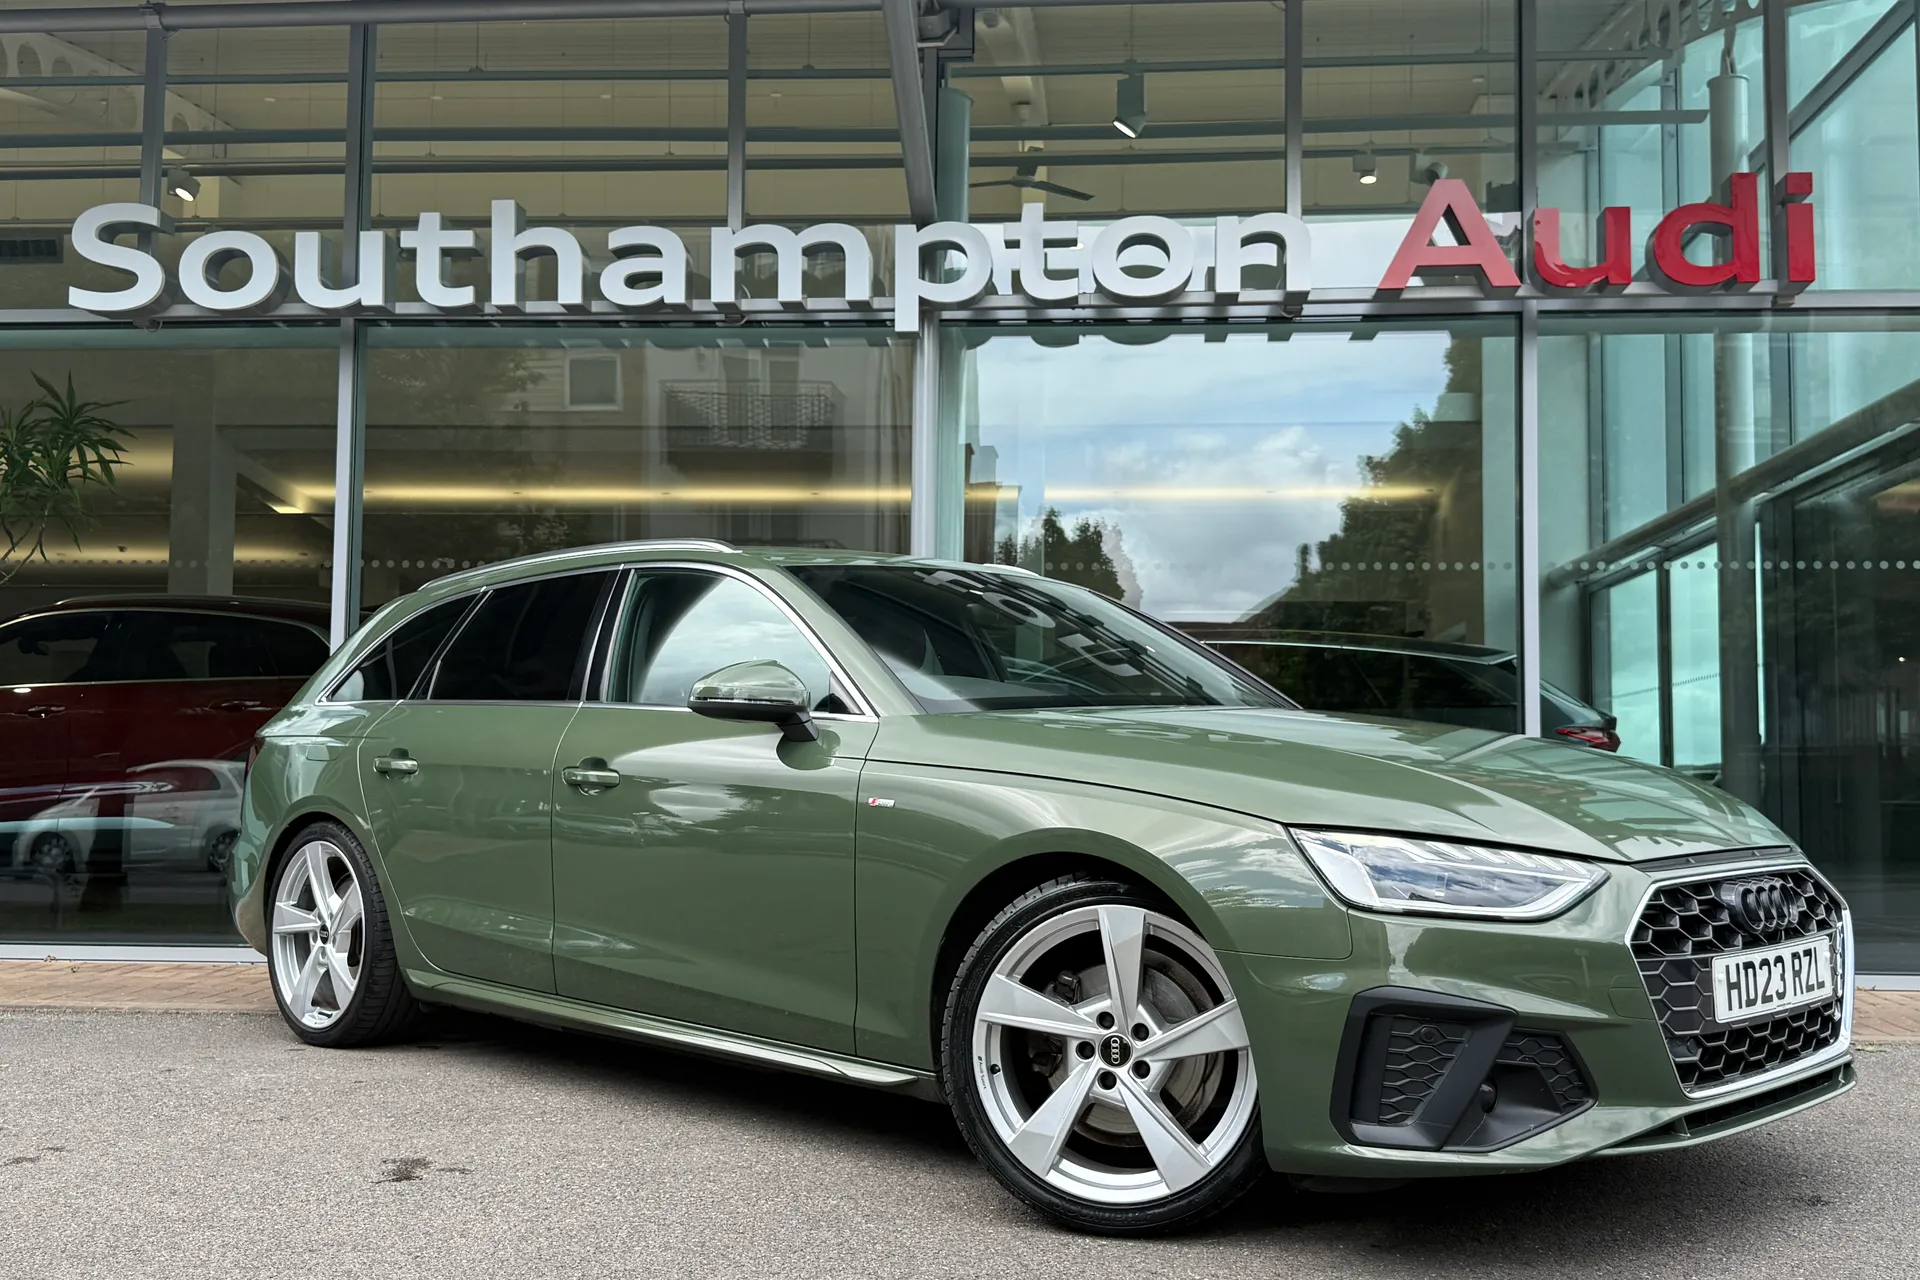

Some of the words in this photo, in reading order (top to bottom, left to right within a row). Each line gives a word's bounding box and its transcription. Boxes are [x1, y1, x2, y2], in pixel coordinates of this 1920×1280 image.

[68, 199, 1311, 334] Southampton
[1377, 172, 1816, 290] Audi
[1725, 955, 1787, 1011] HD23
[1791, 947, 1825, 997] RZL
